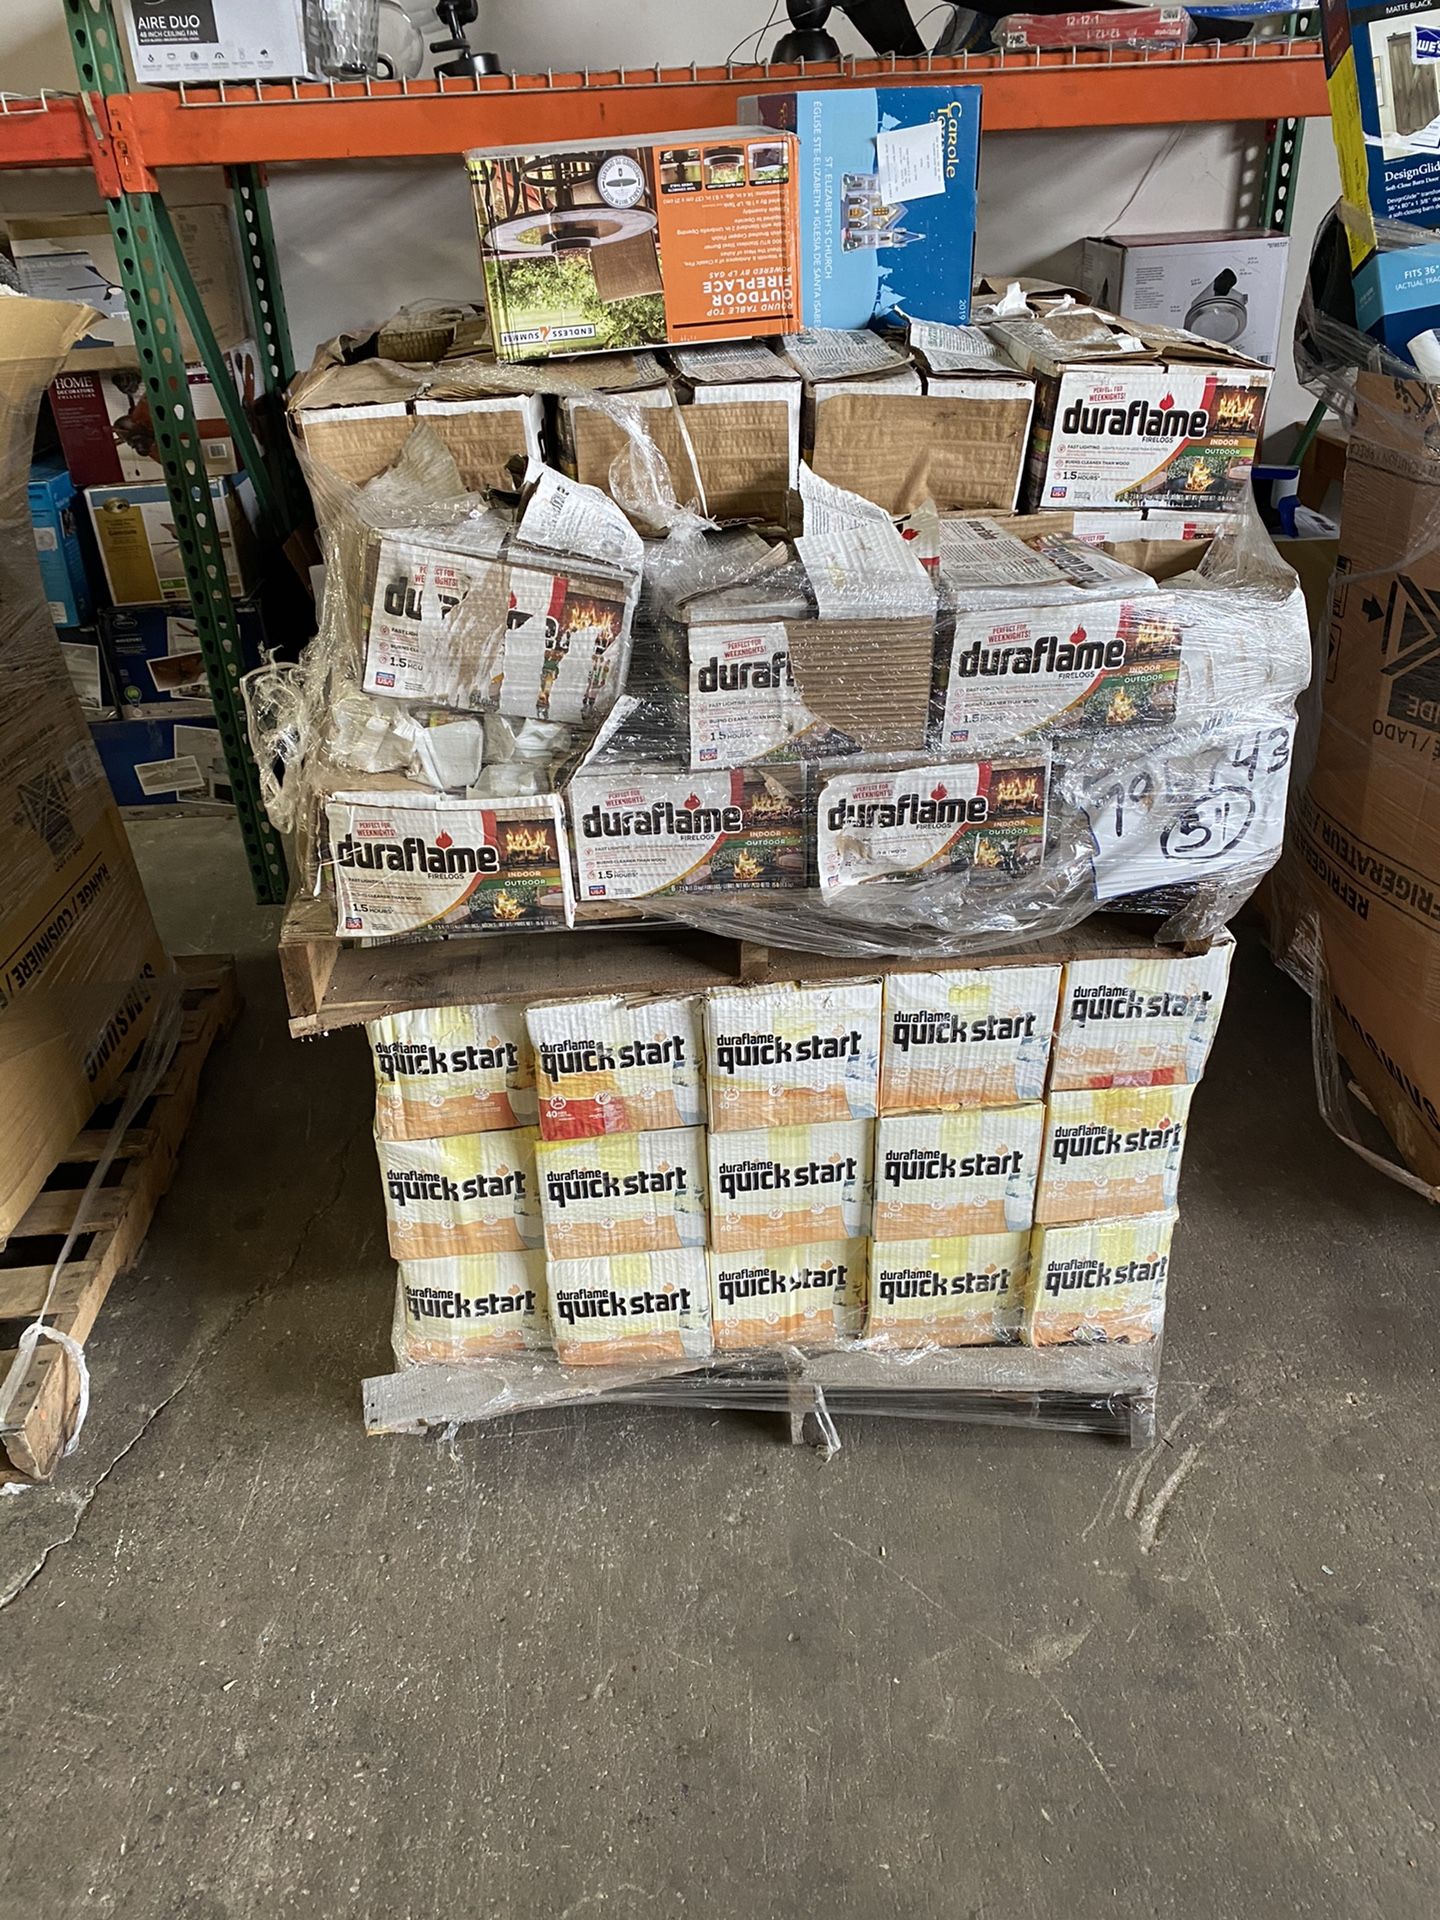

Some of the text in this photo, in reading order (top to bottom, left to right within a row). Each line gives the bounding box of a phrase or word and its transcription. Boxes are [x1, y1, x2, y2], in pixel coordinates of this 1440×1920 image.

[1385, 0, 1432, 14] MATTE BLACK
[138, 14, 200, 30] AIRE DUO
[186, 29, 198, 37] FAN
[812, 101, 823, 135] ÉGLISE
[945, 101, 963, 179] Carole
[812, 137, 823, 207] STE-ELIZABETH
[823, 156, 833, 279] ST. ELIZABETH'S CHURCH
[812, 217, 823, 252] IGLESIA
[812, 254, 823, 264] DE
[708, 271, 725, 279] GAS
[726, 269, 738, 277] LP
[1404, 268, 1422, 280] FITS
[702, 274, 793, 294] FIREPLACE
[812, 266, 823, 298] SANTA
[711, 289, 793, 306] OUTDOOR
[706, 307, 726, 317] TOP
[728, 304, 758, 315] TABLE
[958, 299, 967, 320] 2019
[552, 327, 593, 338] ENDLESS
[54, 376, 94, 389] HOME
[56, 387, 95, 396] DECORATORS
[1089, 392, 1127, 402] WEEKNIGHTS!
[1062, 398, 1208, 438] duraflame
[1141, 436, 1174, 444] FIRELOGS
[1209, 438, 1239, 446] INDOOR
[1062, 471, 1077, 481] 1.5
[443, 569, 455, 578] FOR
[992, 623, 1028, 636] PERFECT FOR
[988, 630, 1031, 644] WEEKNIGHTS!
[723, 645, 767, 659] WEEKNIGHTS!
[958, 636, 1126, 678] duraflame
[389, 656, 407, 669] 1.5
[1129, 664, 1161, 674] INDOOR
[1058, 671, 1096, 680] FIRELOGS
[1124, 673, 1164, 683] OUTDOOR
[1405, 695, 1440, 725] IDE
[963, 713, 980, 724] 1.5
[710, 730, 727, 742] 1.5
[1372, 718, 1418, 749] LADO
[852, 790, 893, 799] WEEKNIGHTS!
[856, 784, 889, 793] PERFECT FOR
[605, 796, 646, 808] WEEKNIGHTS!
[827, 793, 988, 832] duraflame
[358, 821, 391, 830] PERFECT FOR
[581, 802, 743, 839] duraflame
[915, 823, 952, 831] FIRELOGS
[993, 819, 1026, 828] INDOOR
[357, 828, 397, 837] WEEKNIGHTS!
[680, 833, 716, 842] FIRELOGS
[749, 830, 782, 838] INDOOR
[988, 828, 1029, 836] OUTDOOR
[745, 838, 786, 846] OUTDOOR
[337, 833, 500, 874] duraflame
[427, 872, 465, 880] FIRELOGS
[507, 870, 542, 878] INDOOR
[598, 869, 614, 880] 1.5
[77, 863, 110, 908] RANGE
[504, 879, 546, 887] OUTDOOR
[352, 903, 369, 913] 1.5
[11, 905, 74, 991] CUISINIÈRE
[83, 962, 156, 1084] SMSUNG
[893, 1010, 951, 1023] duraflame
[892, 1011, 1037, 1052] quick start
[539, 1039, 596, 1053] duraflame
[716, 1032, 775, 1047] duraflame
[375, 1041, 428, 1055] duraflame
[717, 1030, 863, 1074] quick start
[377, 1041, 518, 1082] quick start
[540, 1035, 686, 1082] quick start
[545, 1110, 558, 1119] 40
[1054, 1124, 1108, 1138] duraflame
[1052, 1123, 1183, 1165] quick start
[885, 1149, 941, 1162] duraflame
[718, 1160, 774, 1174] duraflame
[884, 1150, 1024, 1187] quick start
[386, 1168, 441, 1182] duraflame
[546, 1168, 602, 1183] duraflame
[718, 1157, 858, 1200] quick start
[388, 1170, 527, 1207] quick start
[547, 1166, 688, 1208] quick start
[1047, 1258, 1099, 1272] duraflame
[718, 1267, 770, 1282] duraflame
[879, 1268, 933, 1281] duraflame
[1044, 1255, 1169, 1297] quick start
[405, 1284, 454, 1299] duraflame
[718, 1269, 787, 1305] quick
[879, 1268, 1012, 1305] quick start
[556, 1287, 609, 1301] duraflame
[406, 1289, 537, 1321] quick start
[557, 1287, 692, 1325] quick start
